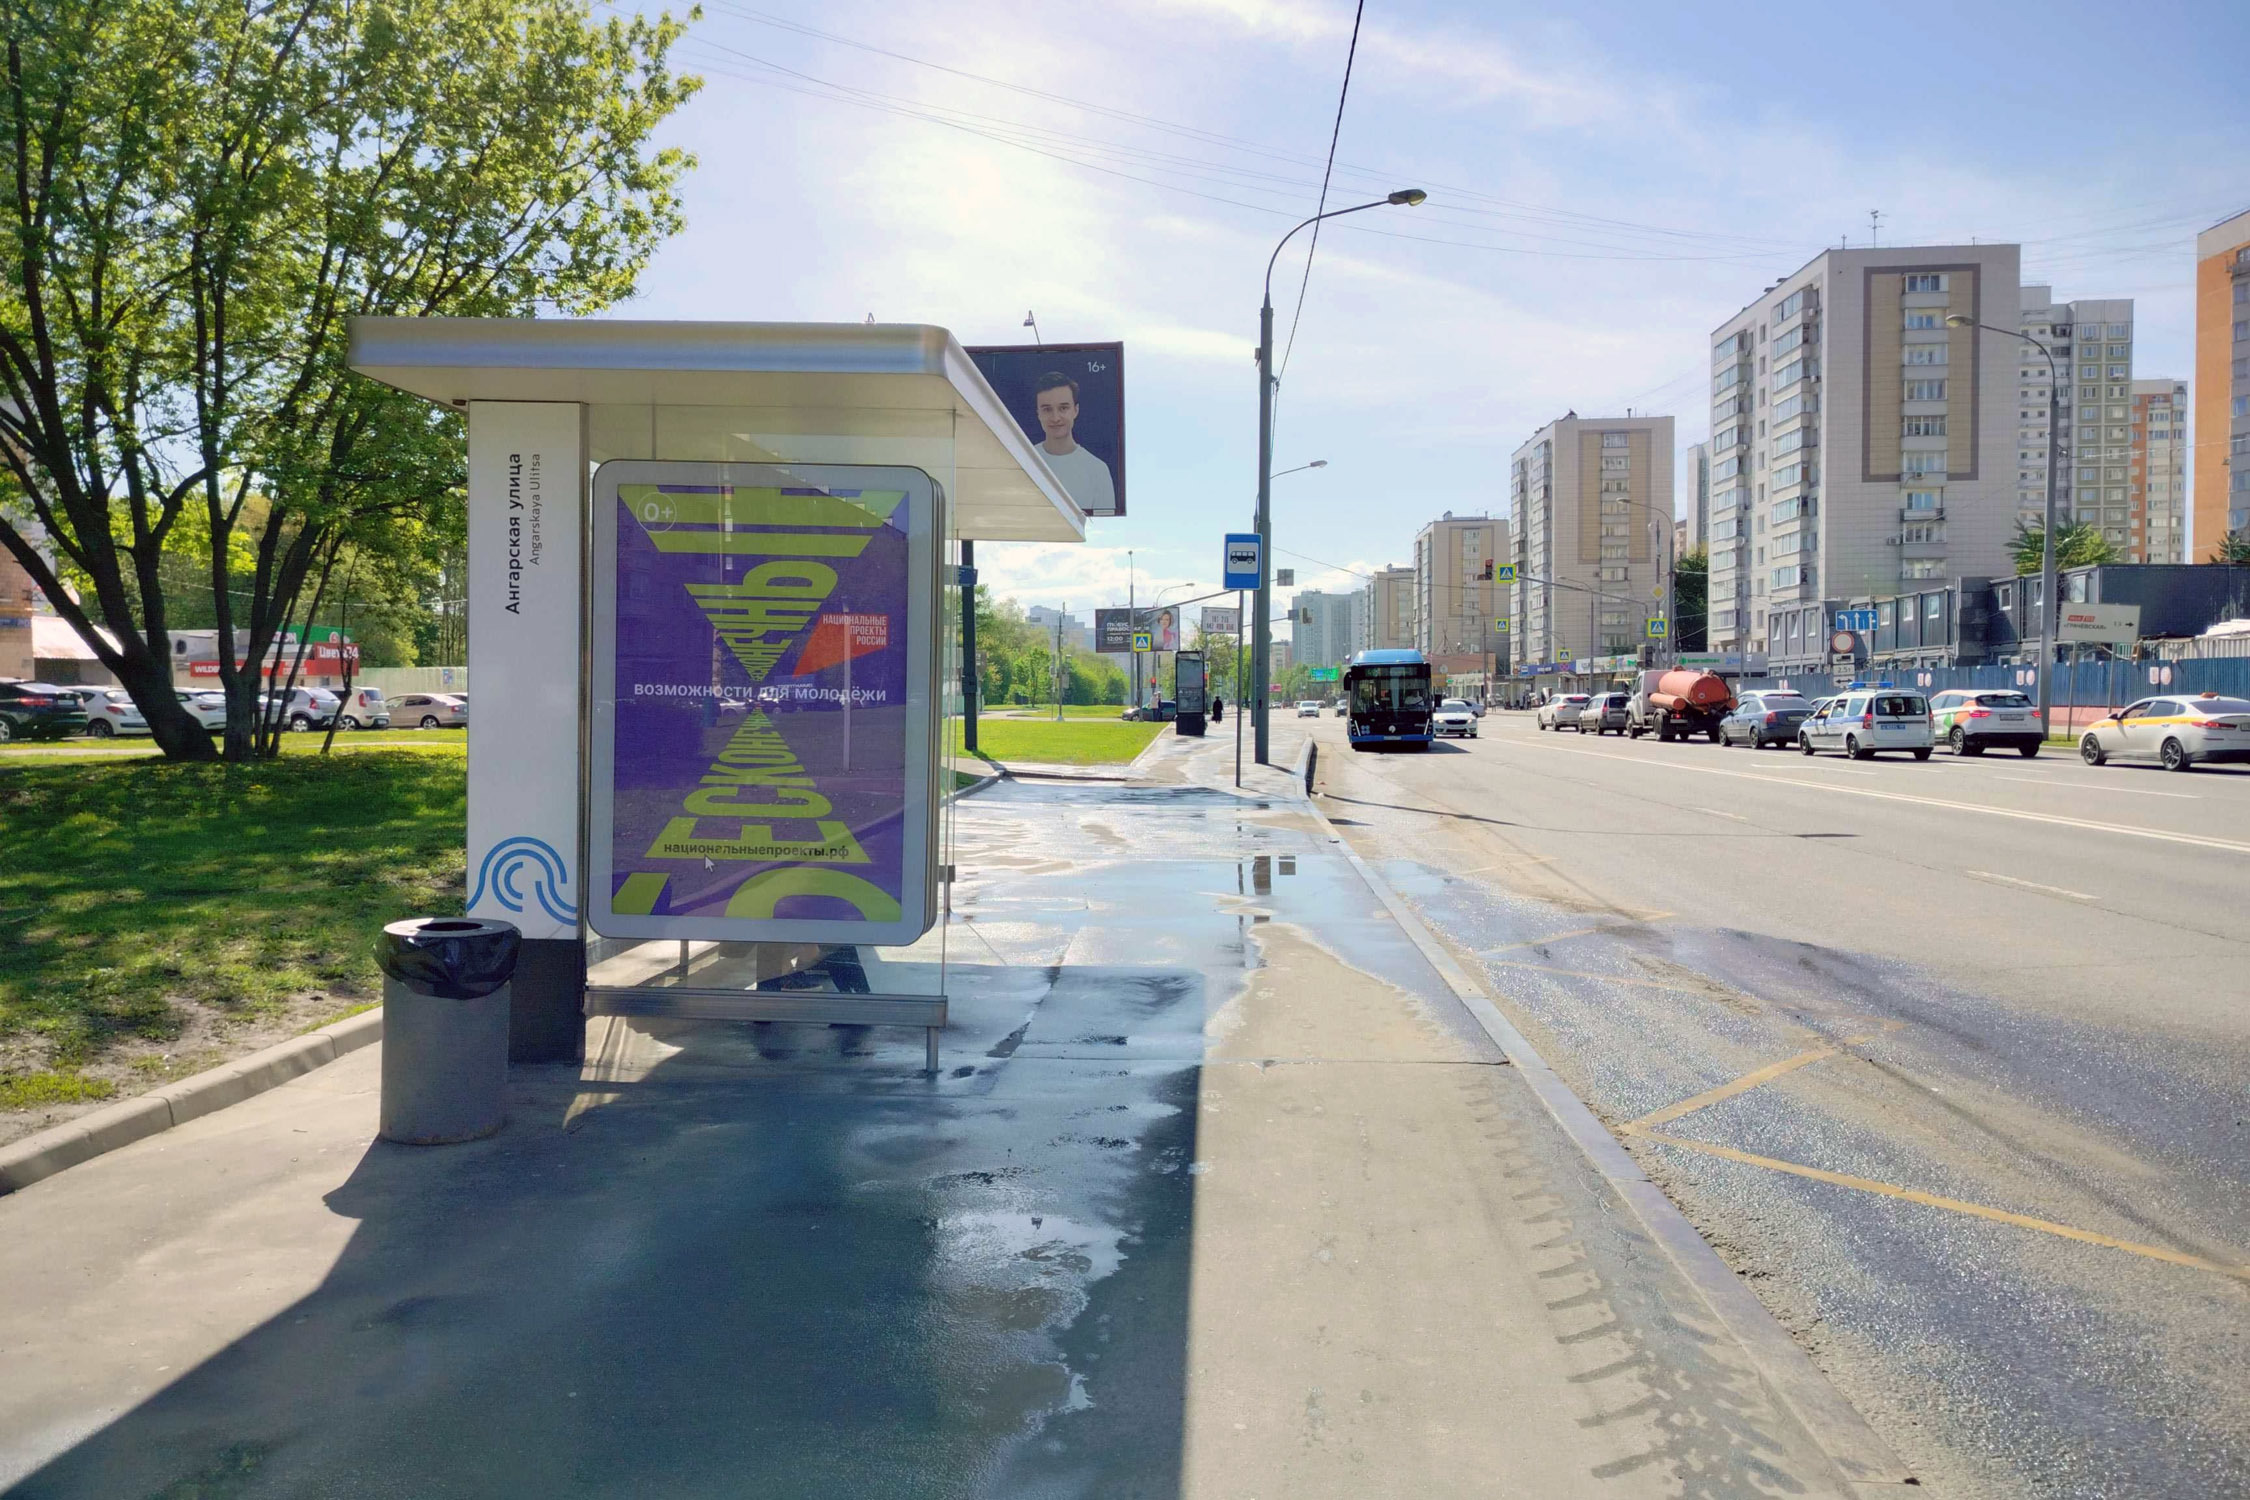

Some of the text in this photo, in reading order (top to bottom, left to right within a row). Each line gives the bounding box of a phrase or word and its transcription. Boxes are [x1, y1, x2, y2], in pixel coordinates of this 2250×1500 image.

[1087, 361, 1106, 373] 16+
[529, 453, 543, 566] Angarskaya Ulitsa
[644, 503, 674, 521] 0+
[505, 453, 524, 615] Ангарская улица
[822, 614, 887, 626] НАЦИОНАЛЬНЫЕ
[849, 625, 887, 636] ПРОЕКТЫ
[856, 636, 887, 646] РОССИИ
[634, 683, 752, 699] возможности
[794, 686, 887, 703] молодёжи
[663, 843, 850, 860] национальныепроекты.рф
